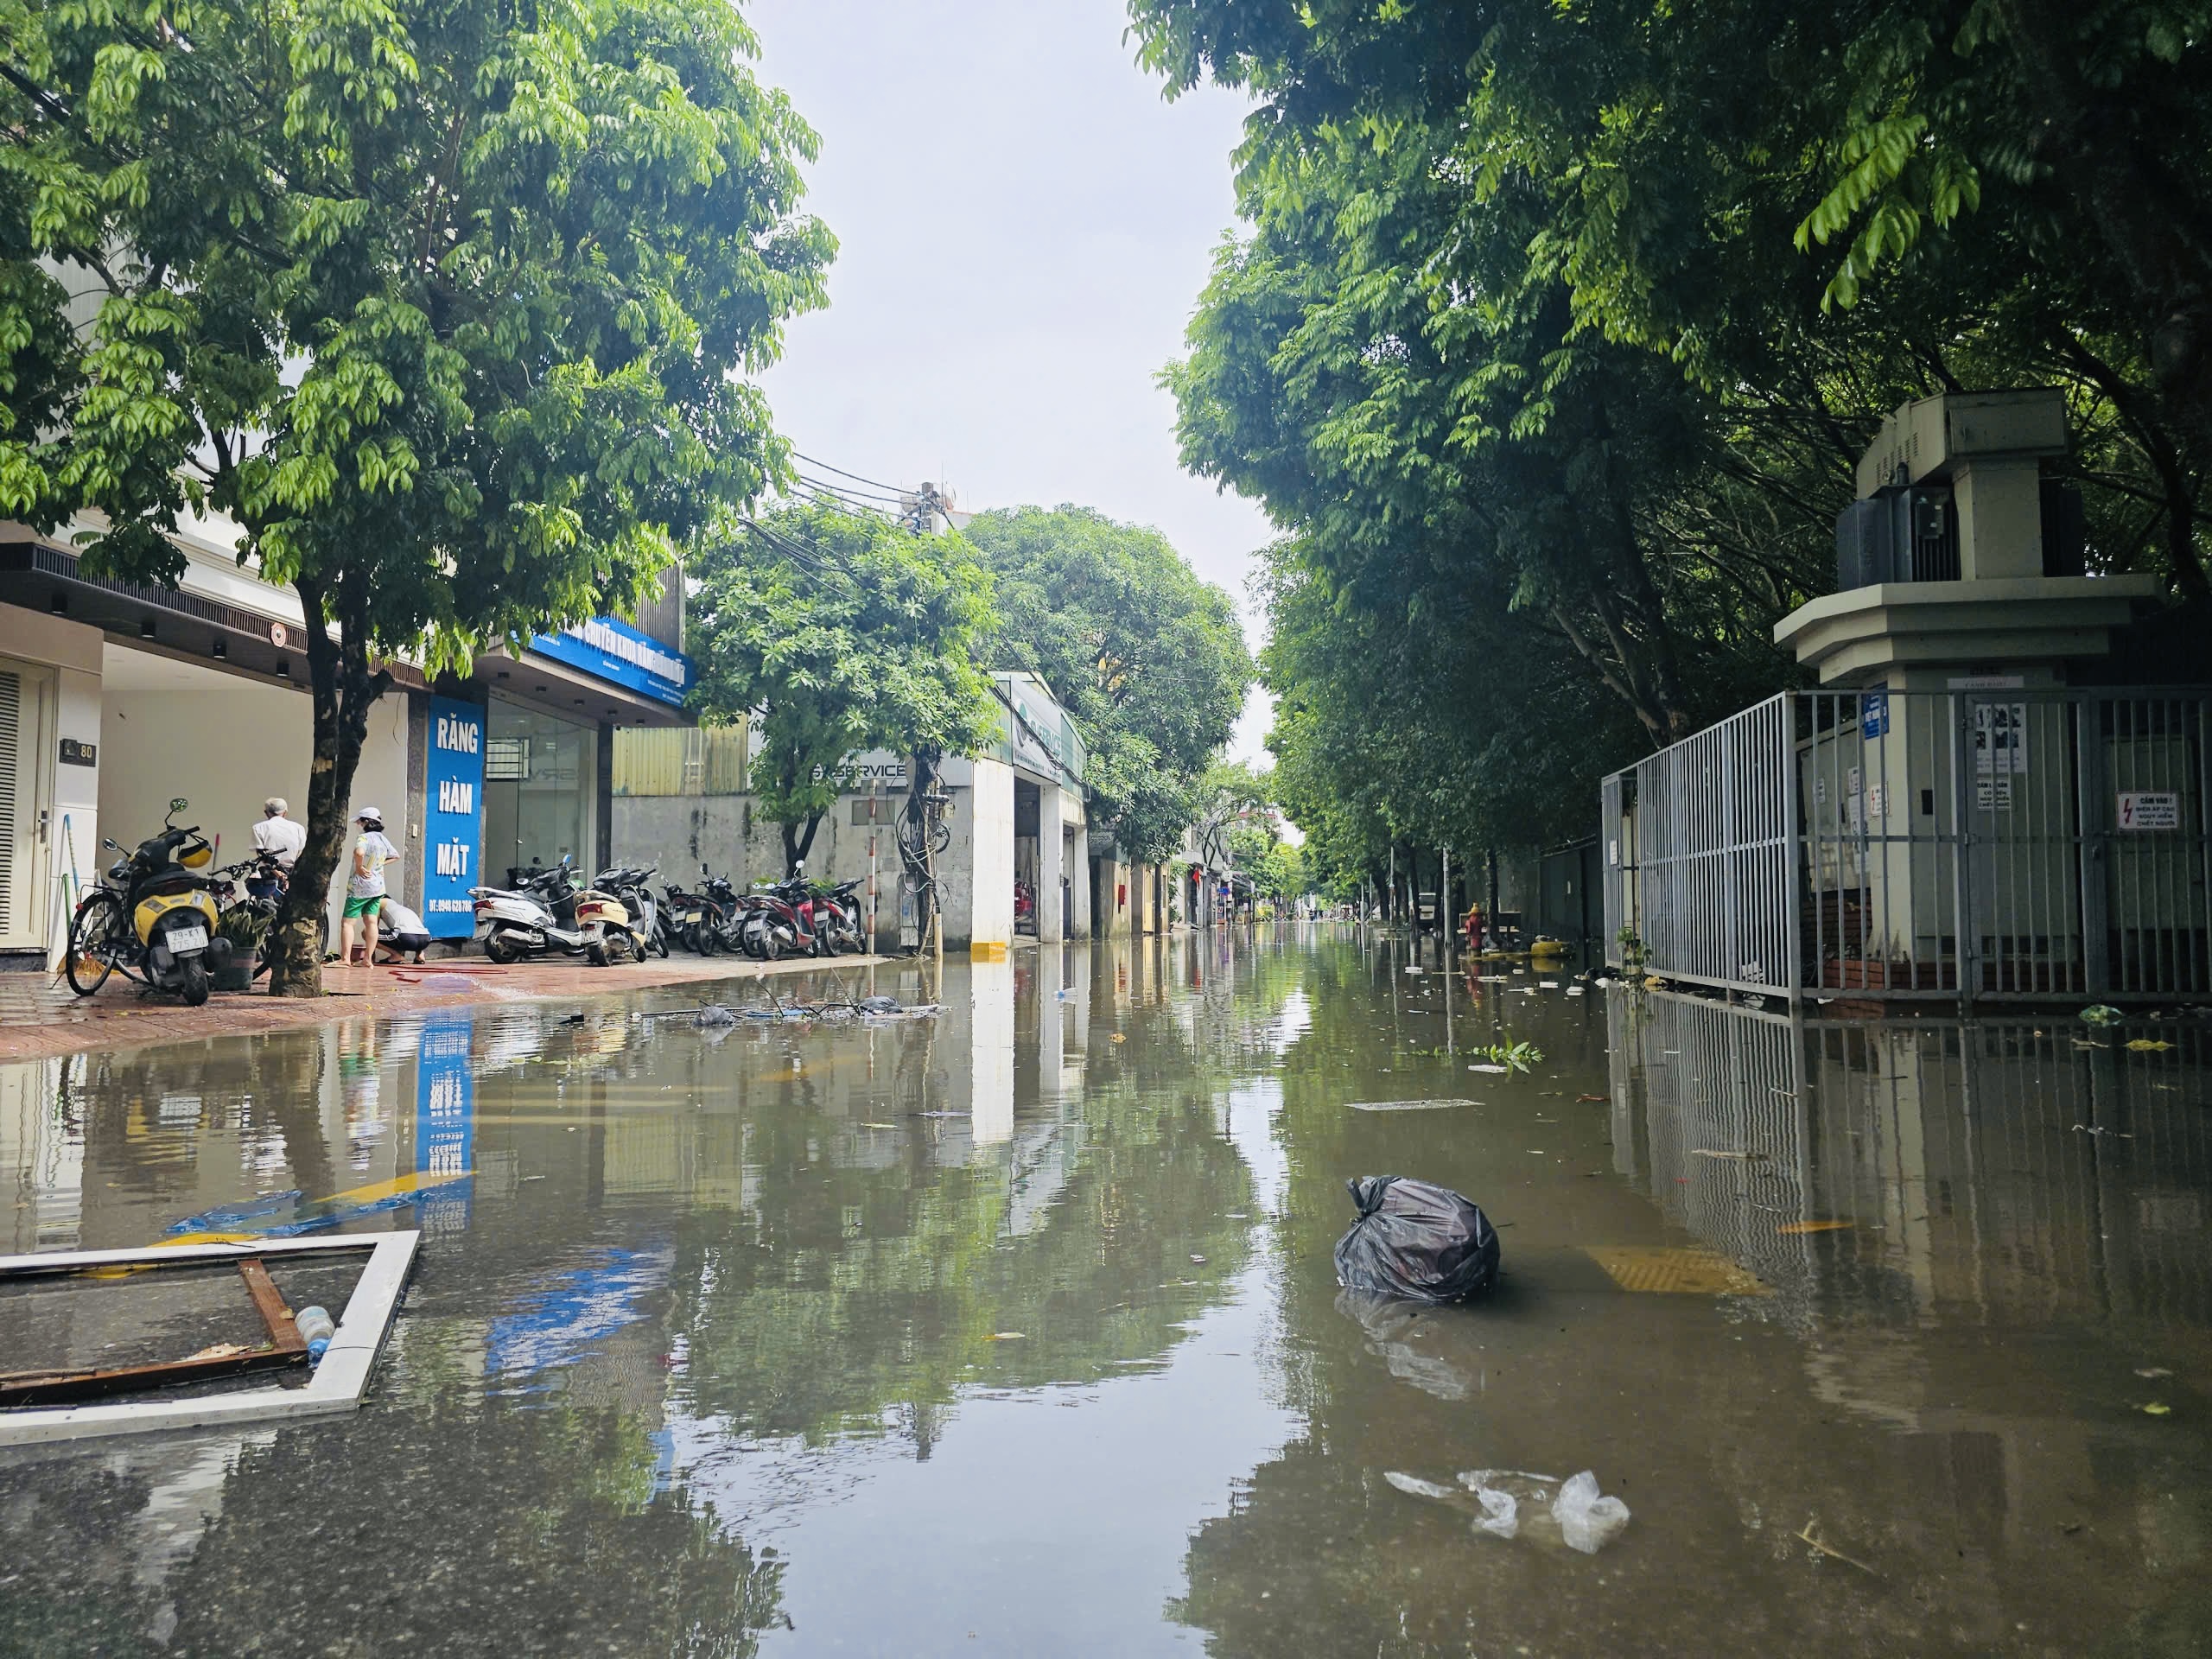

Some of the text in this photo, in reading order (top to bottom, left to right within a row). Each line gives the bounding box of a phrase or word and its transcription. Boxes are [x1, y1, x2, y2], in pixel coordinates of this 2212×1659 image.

[80, 745, 92, 758] 80
[437, 713, 479, 753] RĂNG
[439, 775, 473, 815] HÀM
[436, 837, 469, 882] MẶT
[173, 928, 199, 942] 29-K1
